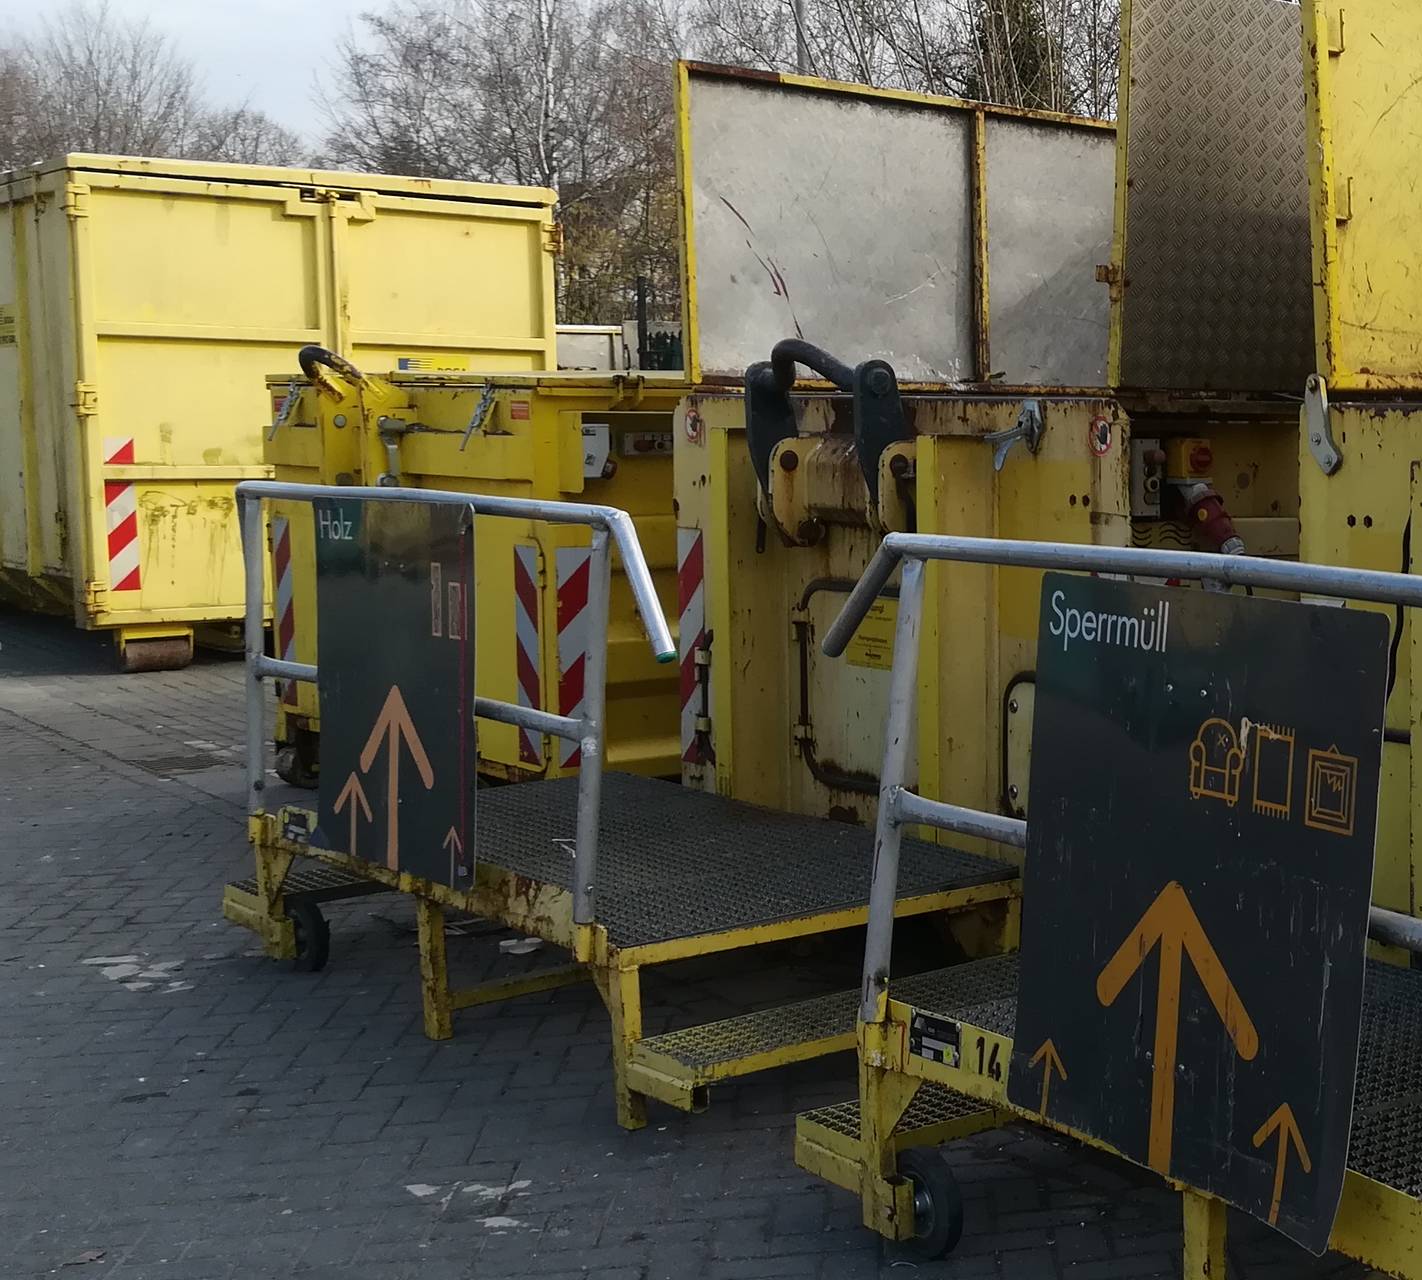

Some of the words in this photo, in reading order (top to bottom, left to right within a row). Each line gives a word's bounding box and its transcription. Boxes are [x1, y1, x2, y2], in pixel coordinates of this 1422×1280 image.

[319, 508, 353, 540] Holz
[1049, 590, 1170, 653] Sperrmüll
[976, 1036, 1002, 1082] 14
